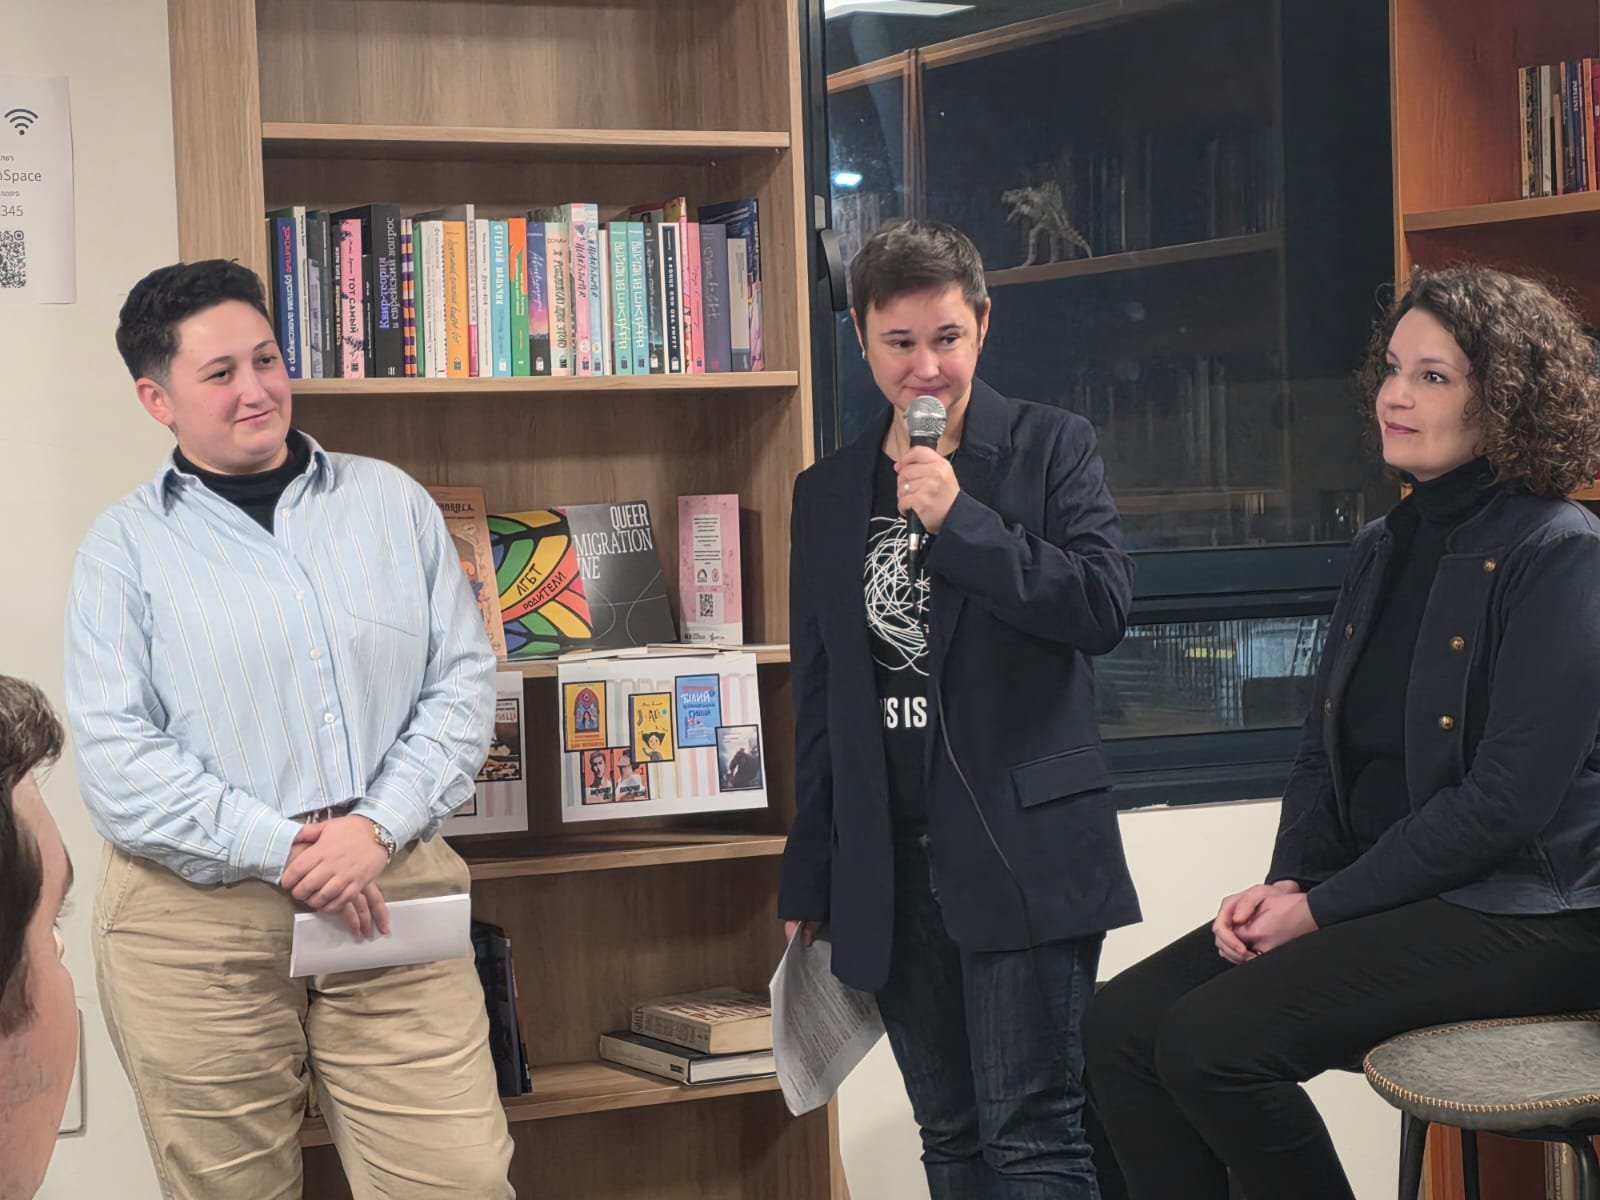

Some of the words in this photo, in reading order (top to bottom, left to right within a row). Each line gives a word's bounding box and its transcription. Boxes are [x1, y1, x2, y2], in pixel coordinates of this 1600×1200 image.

[386, 217, 398, 257] вопрос
[348, 277, 356, 297] ТОТ
[575, 242, 586, 298] HEARTSTOPPER
[588, 244, 598, 298] HEARTSTOPPER
[388, 259, 399, 320] еврейский
[350, 298, 359, 334] САМЫЙ
[610, 503, 649, 531] QUEER
[572, 528, 653, 557] MIGRATION
[516, 562, 543, 597] ЛГБТ
[523, 571, 567, 611] РОДИТЕЛИ
[904, 697, 928, 728] IS
